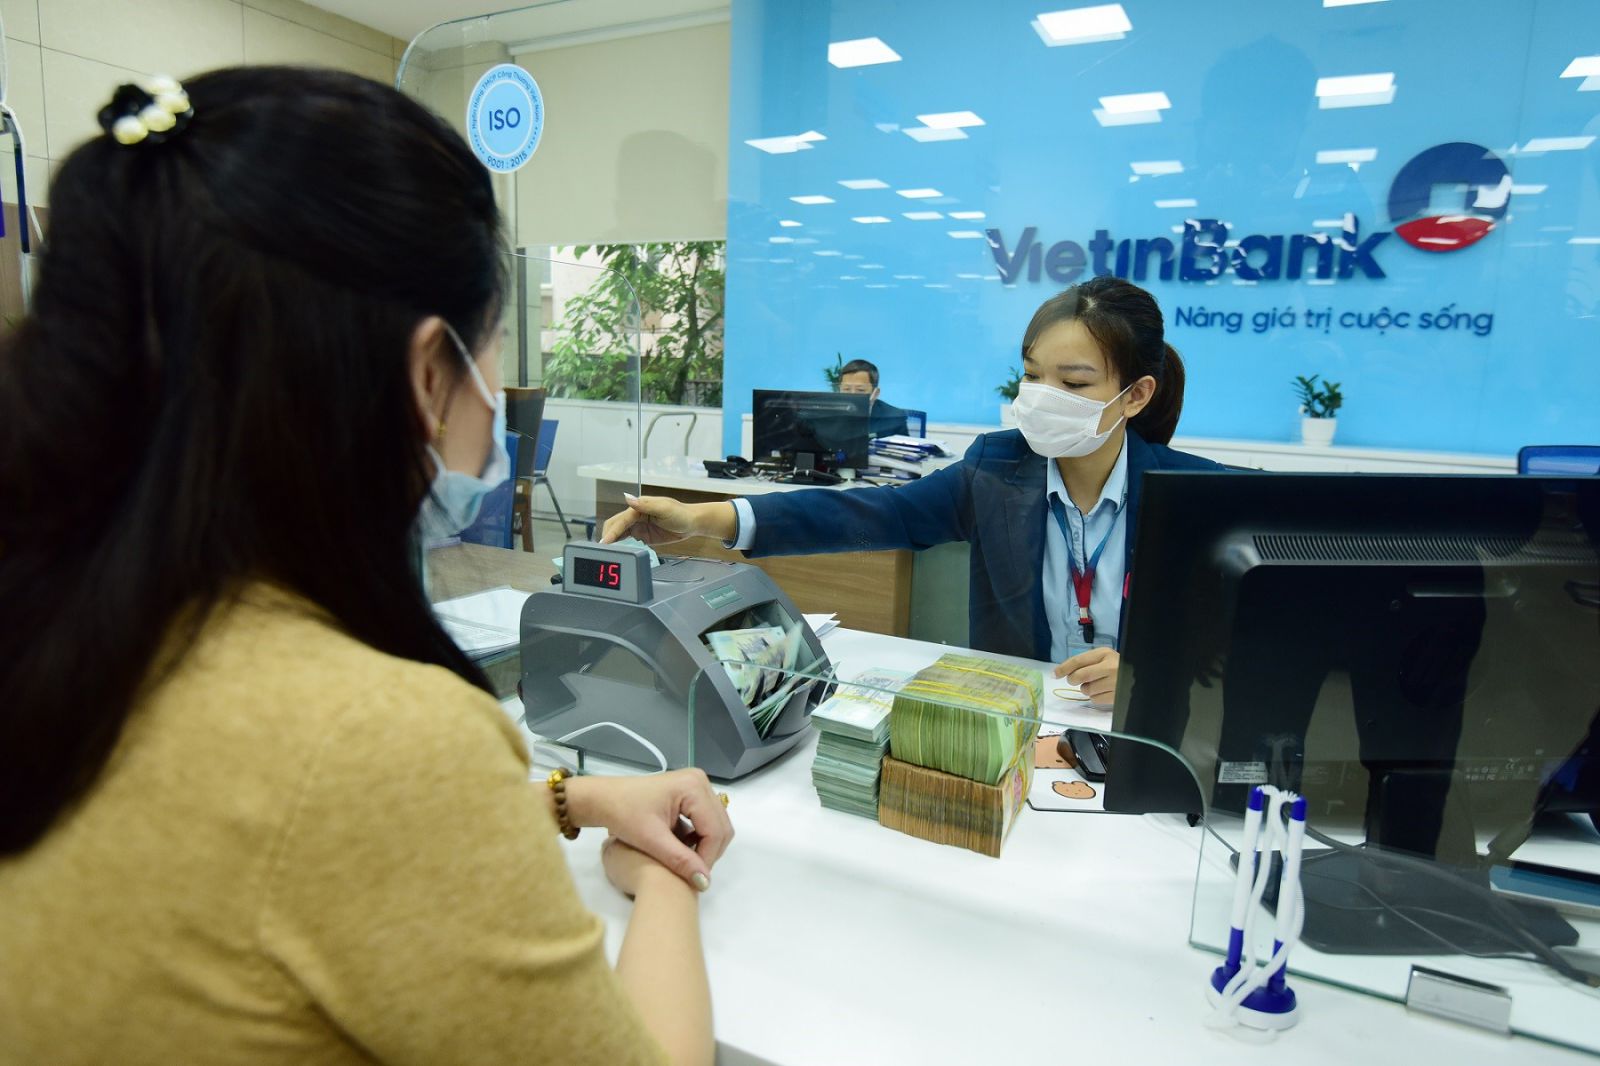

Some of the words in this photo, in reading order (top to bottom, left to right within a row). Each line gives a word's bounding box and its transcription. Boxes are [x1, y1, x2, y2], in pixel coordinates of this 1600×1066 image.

[488, 107, 521, 131] ISO
[487, 155, 505, 169] 9001
[510, 151, 528, 168] 2015
[986, 212, 1392, 285] VietinBank
[1175, 306, 1243, 333] Nâng
[1252, 306, 1296, 333] giá
[1304, 306, 1332, 334] trị
[1339, 306, 1410, 335] cuộc
[1418, 303, 1494, 336] sống
[598, 564, 621, 586] 15
